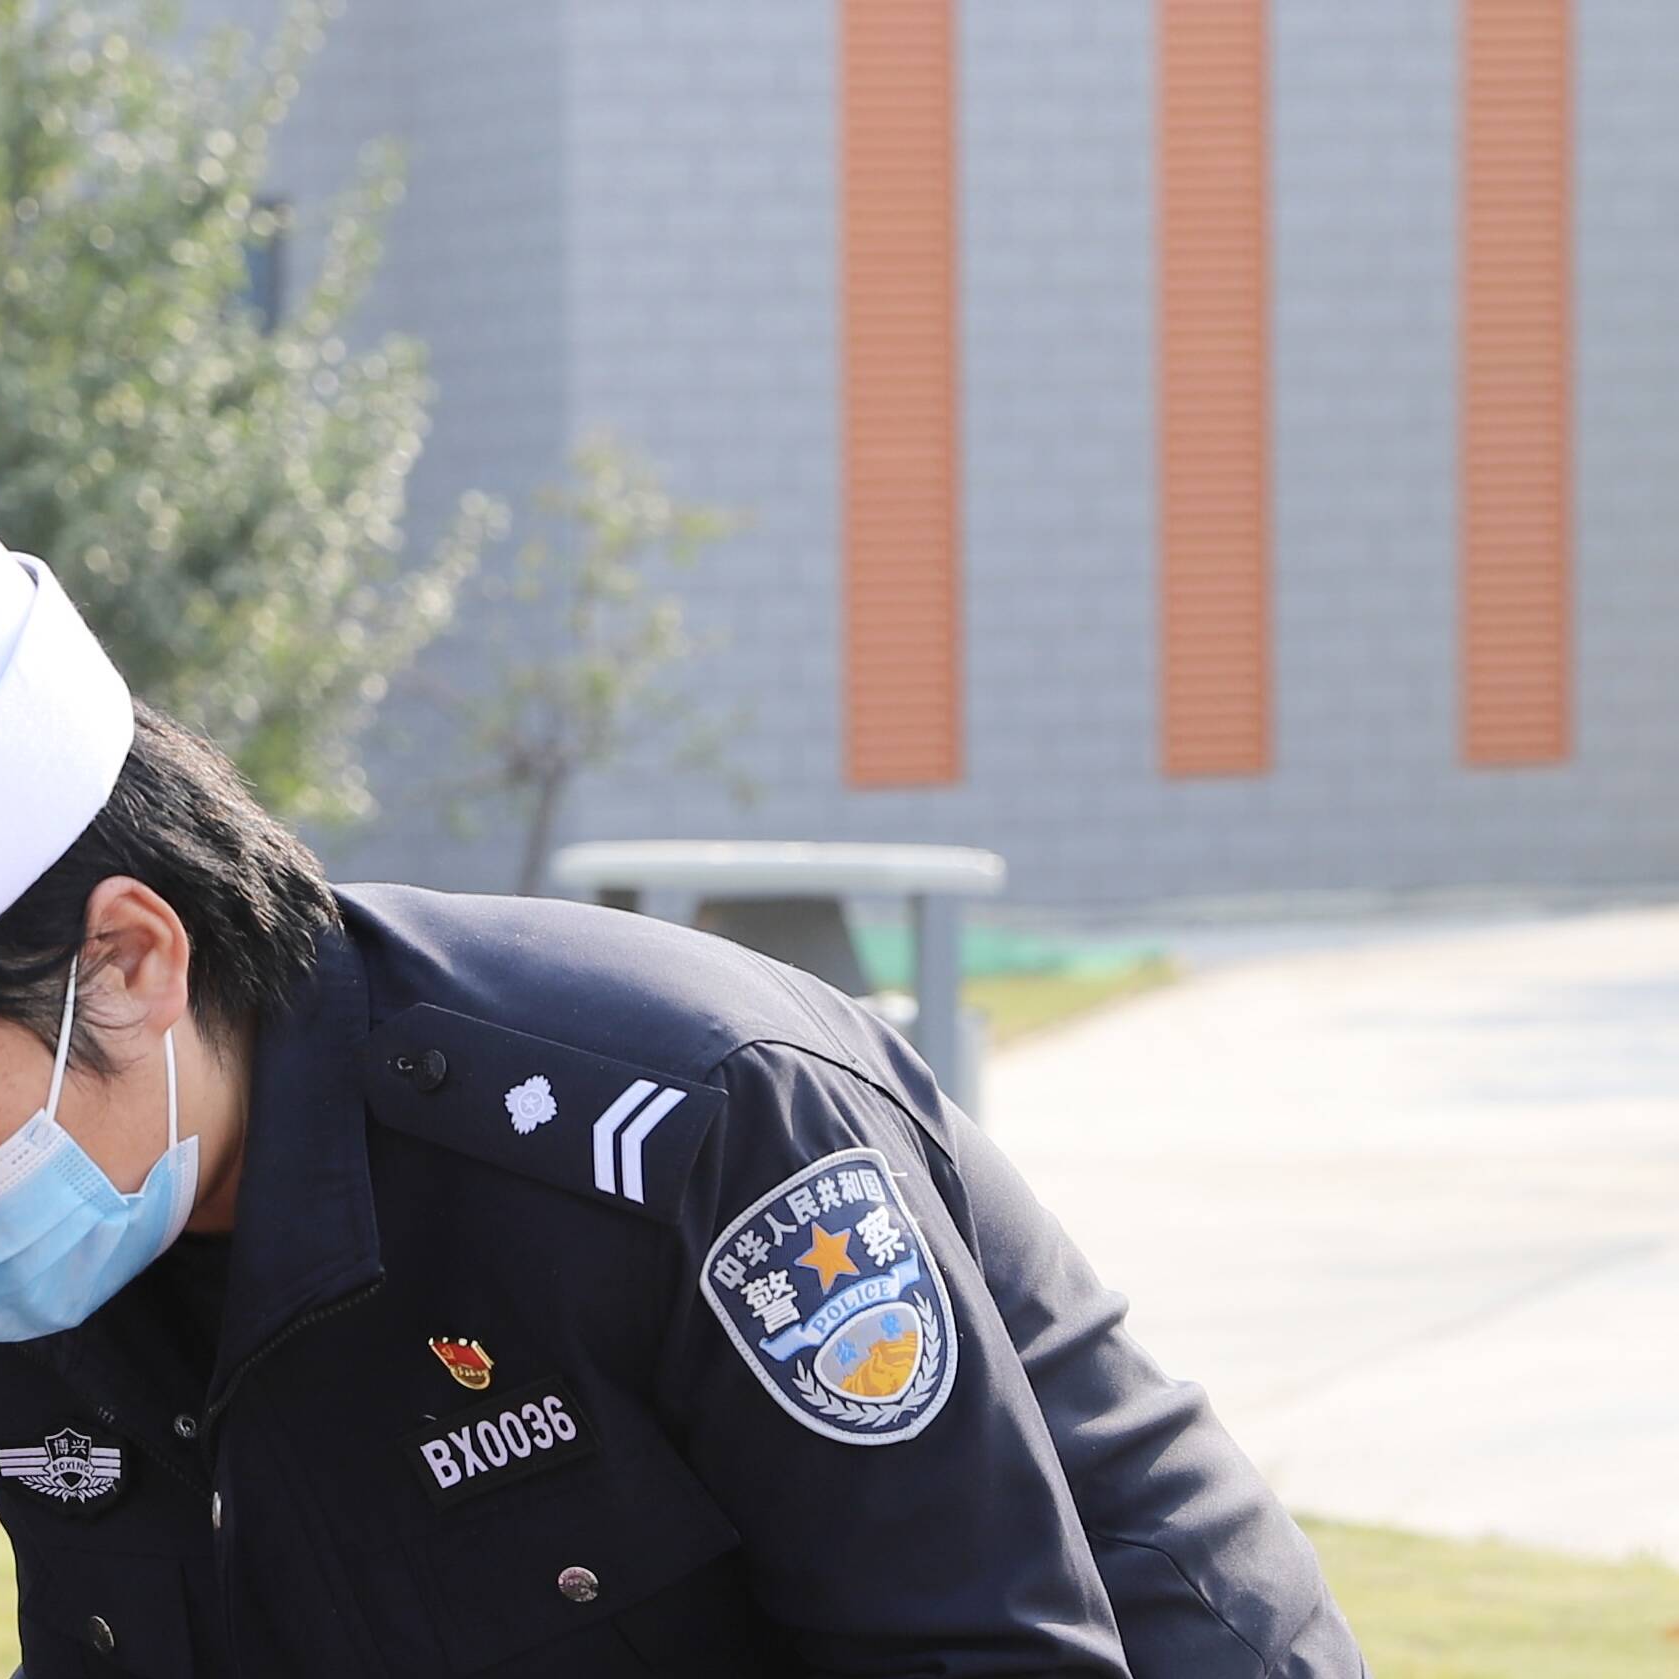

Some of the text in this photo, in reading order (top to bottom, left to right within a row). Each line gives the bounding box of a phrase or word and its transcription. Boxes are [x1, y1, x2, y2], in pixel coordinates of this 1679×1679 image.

[713, 1168, 887, 1291] 中华人民共和国
[811, 1280, 892, 1336] POLICE
[52, 1461, 90, 1473] BOXING
[53, 1437, 87, 1455] 博兴
[419, 1395, 577, 1489] BX0036
